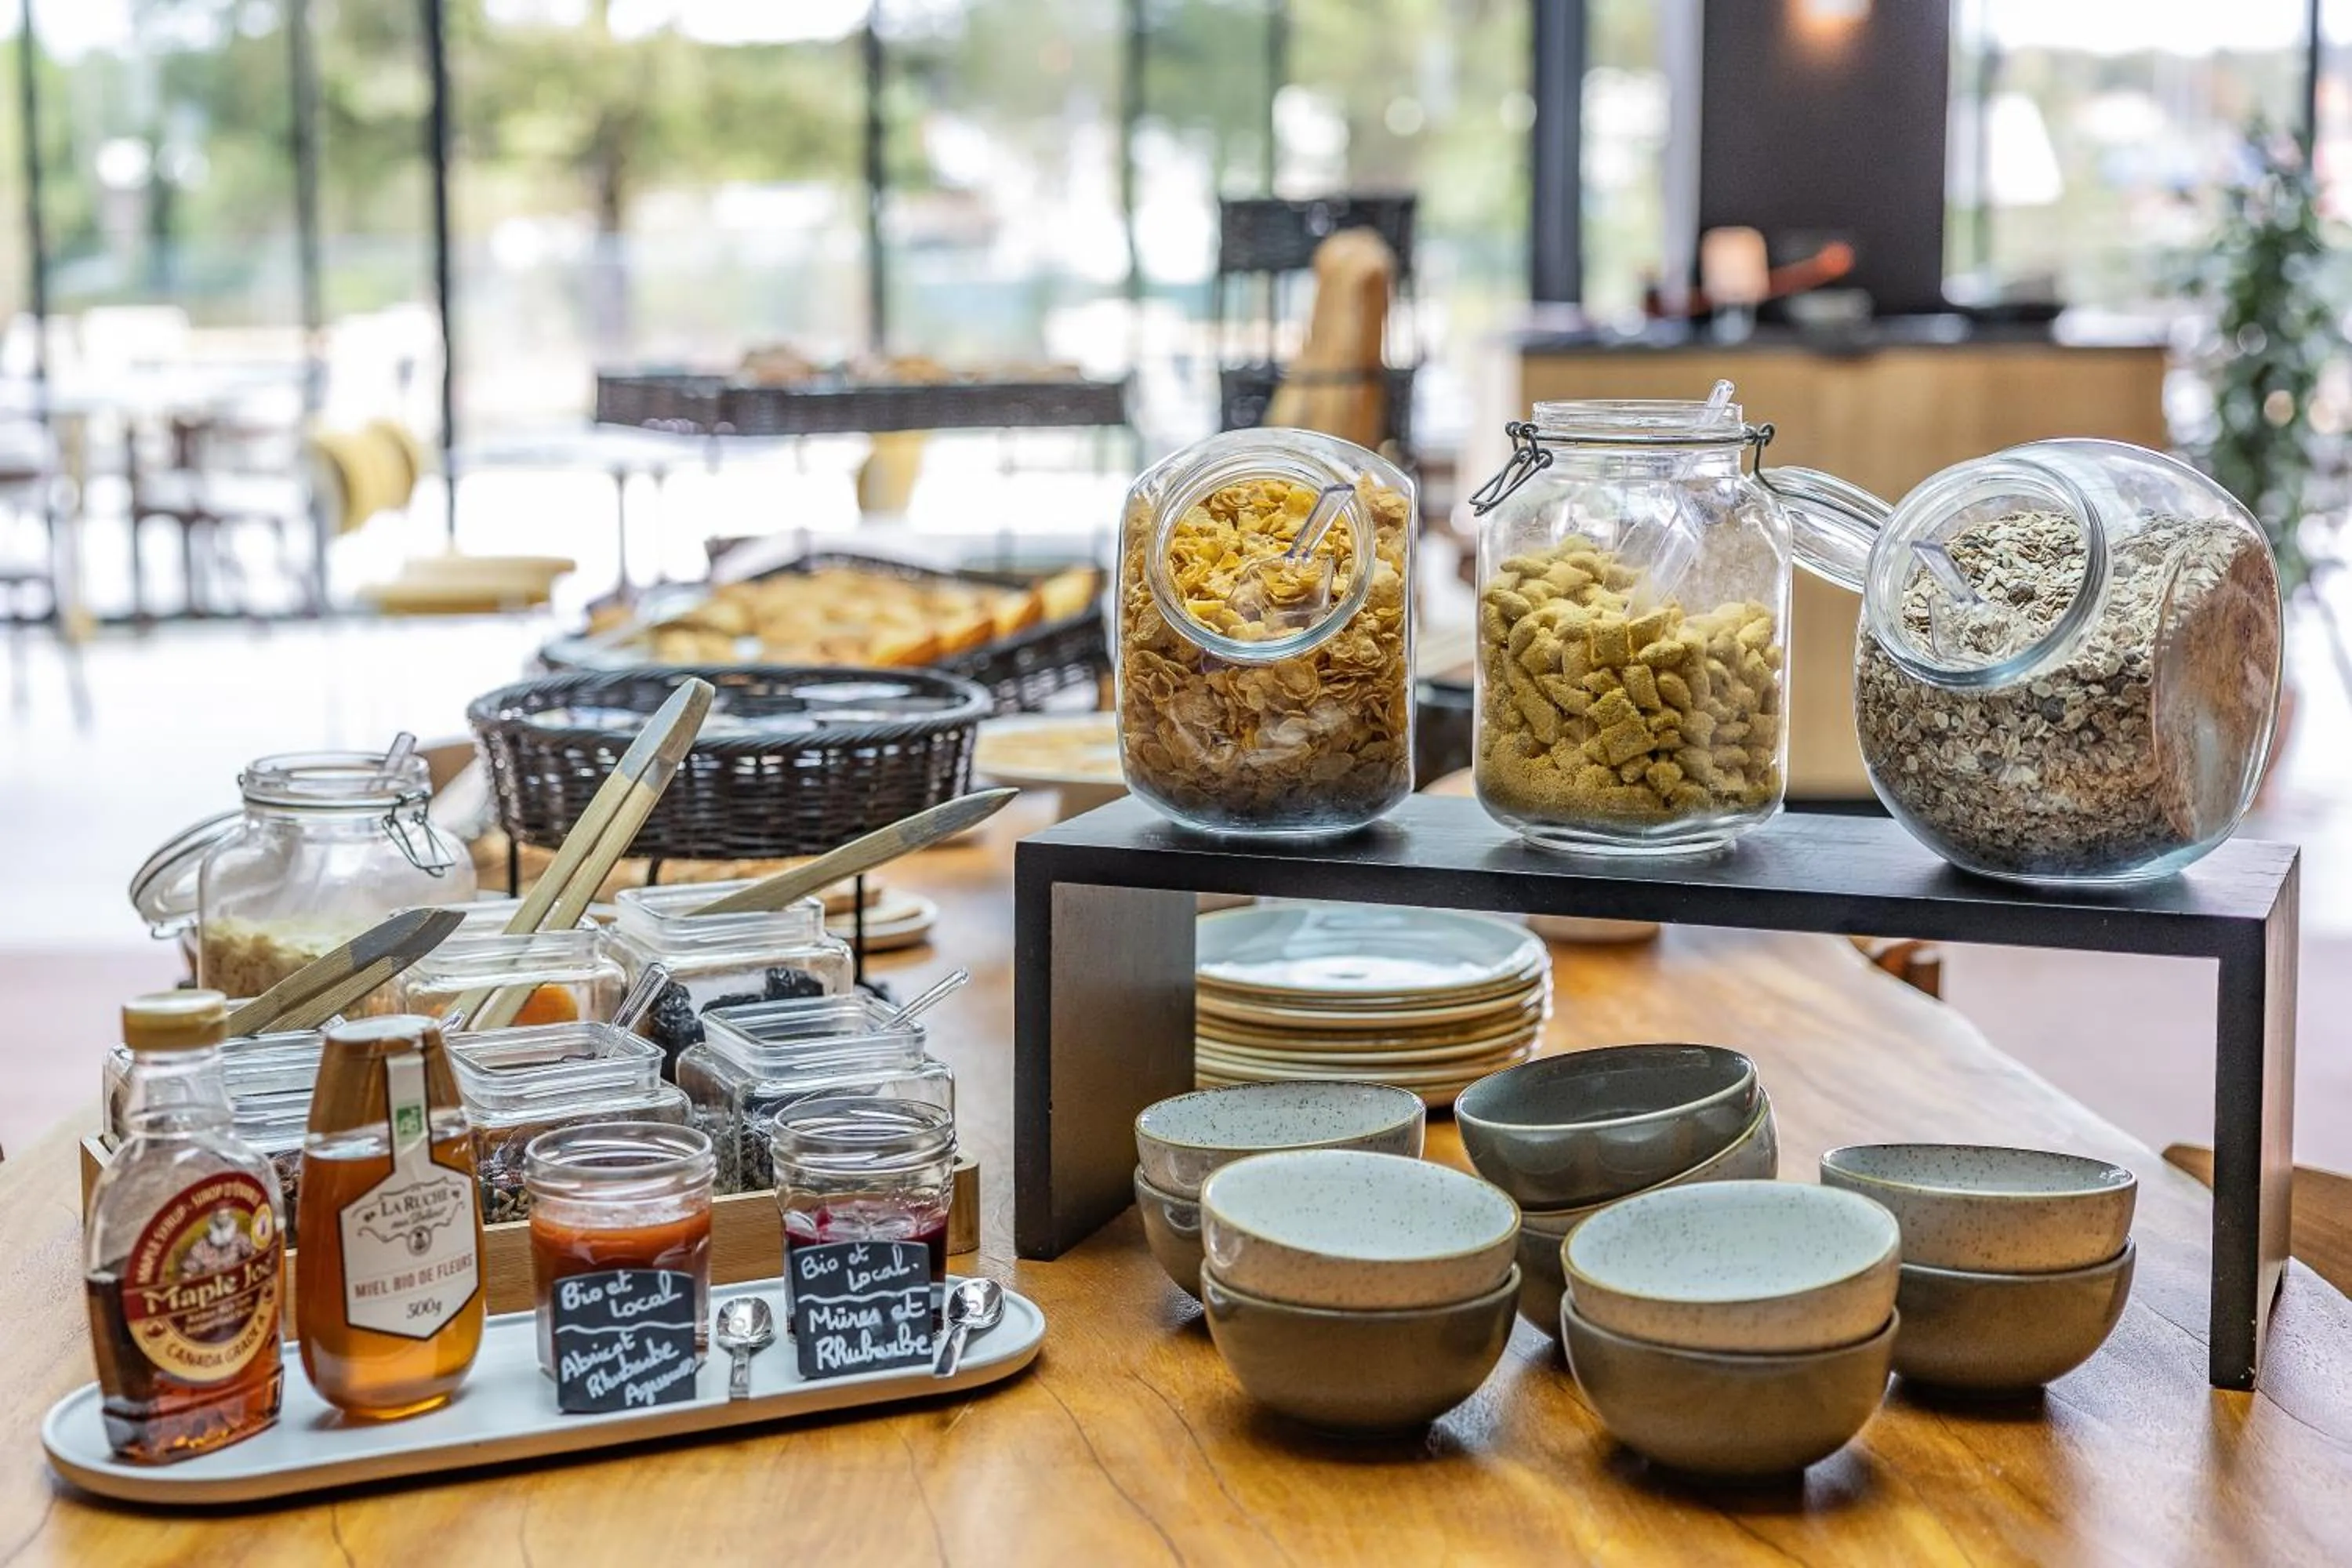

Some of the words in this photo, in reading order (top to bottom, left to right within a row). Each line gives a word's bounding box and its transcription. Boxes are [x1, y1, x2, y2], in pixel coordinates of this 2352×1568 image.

[380, 1201, 402, 1218] LA
[354, 1280, 388, 1298] MIEL
[393, 1272, 416, 1291] BIO
[418, 1267, 434, 1284] DE
[437, 1254, 474, 1279] FLEURS
[800, 1254, 839, 1280] Bio
[848, 1241, 869, 1265] et
[142, 1274, 238, 1314] Maple
[405, 1298, 443, 1320] 500g
[561, 1281, 604, 1311] Bio
[605, 1269, 633, 1295] et
[609, 1269, 683, 1318] Local
[891, 1293, 927, 1321] et
[165, 1343, 222, 1369] CANADA
[815, 1322, 933, 1371] Rhubarbe
